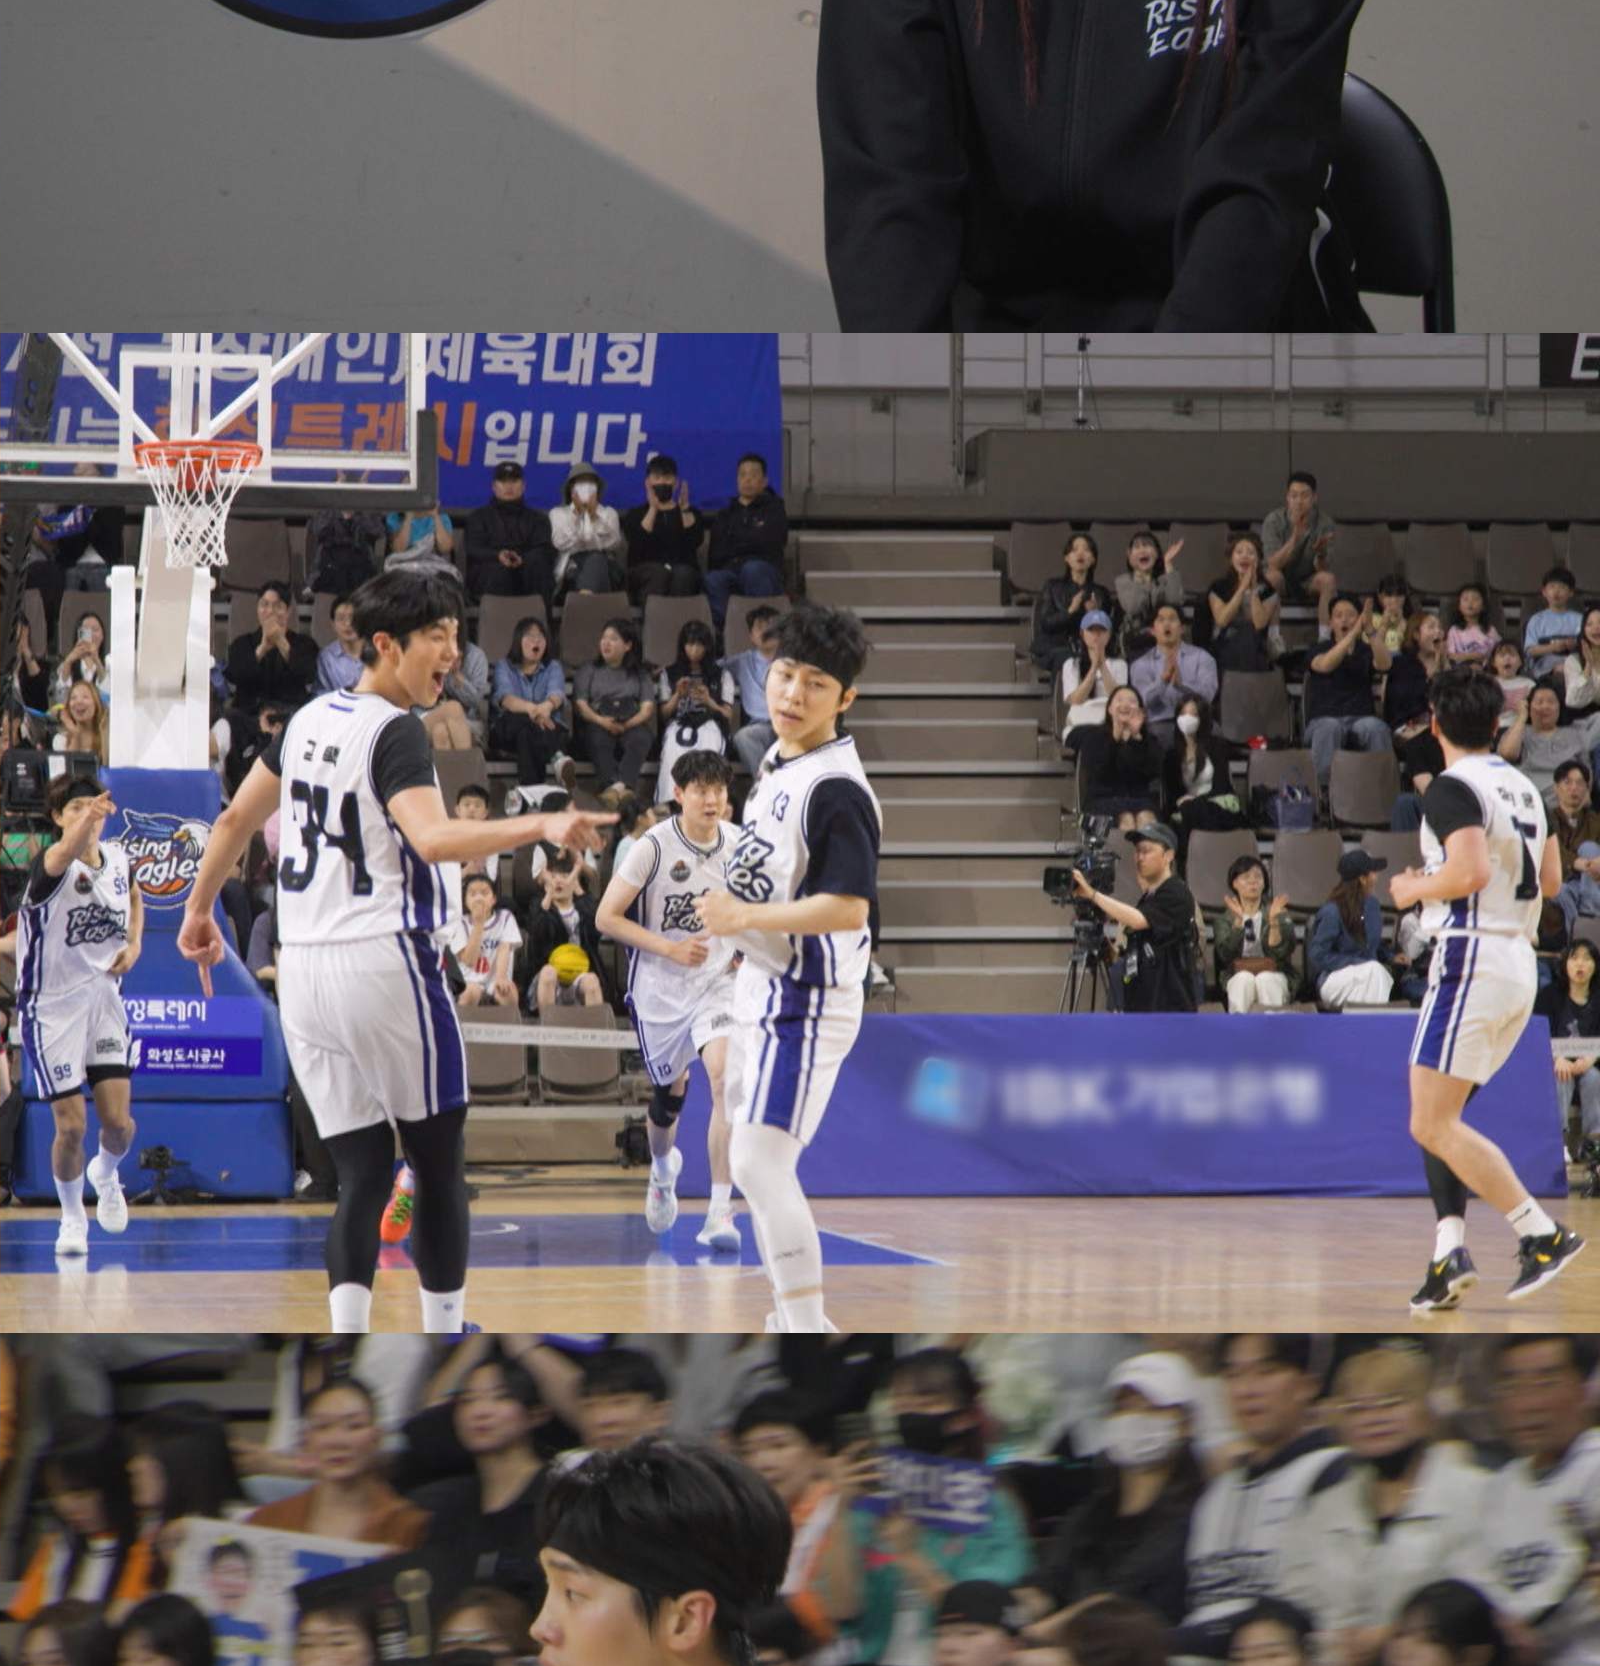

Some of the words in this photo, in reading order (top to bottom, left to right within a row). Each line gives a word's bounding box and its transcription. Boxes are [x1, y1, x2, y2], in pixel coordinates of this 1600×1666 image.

[279, 779, 374, 896] 34
[133, 856, 202, 884] agles
[147, 1047, 226, 1063] 화성도시공사
